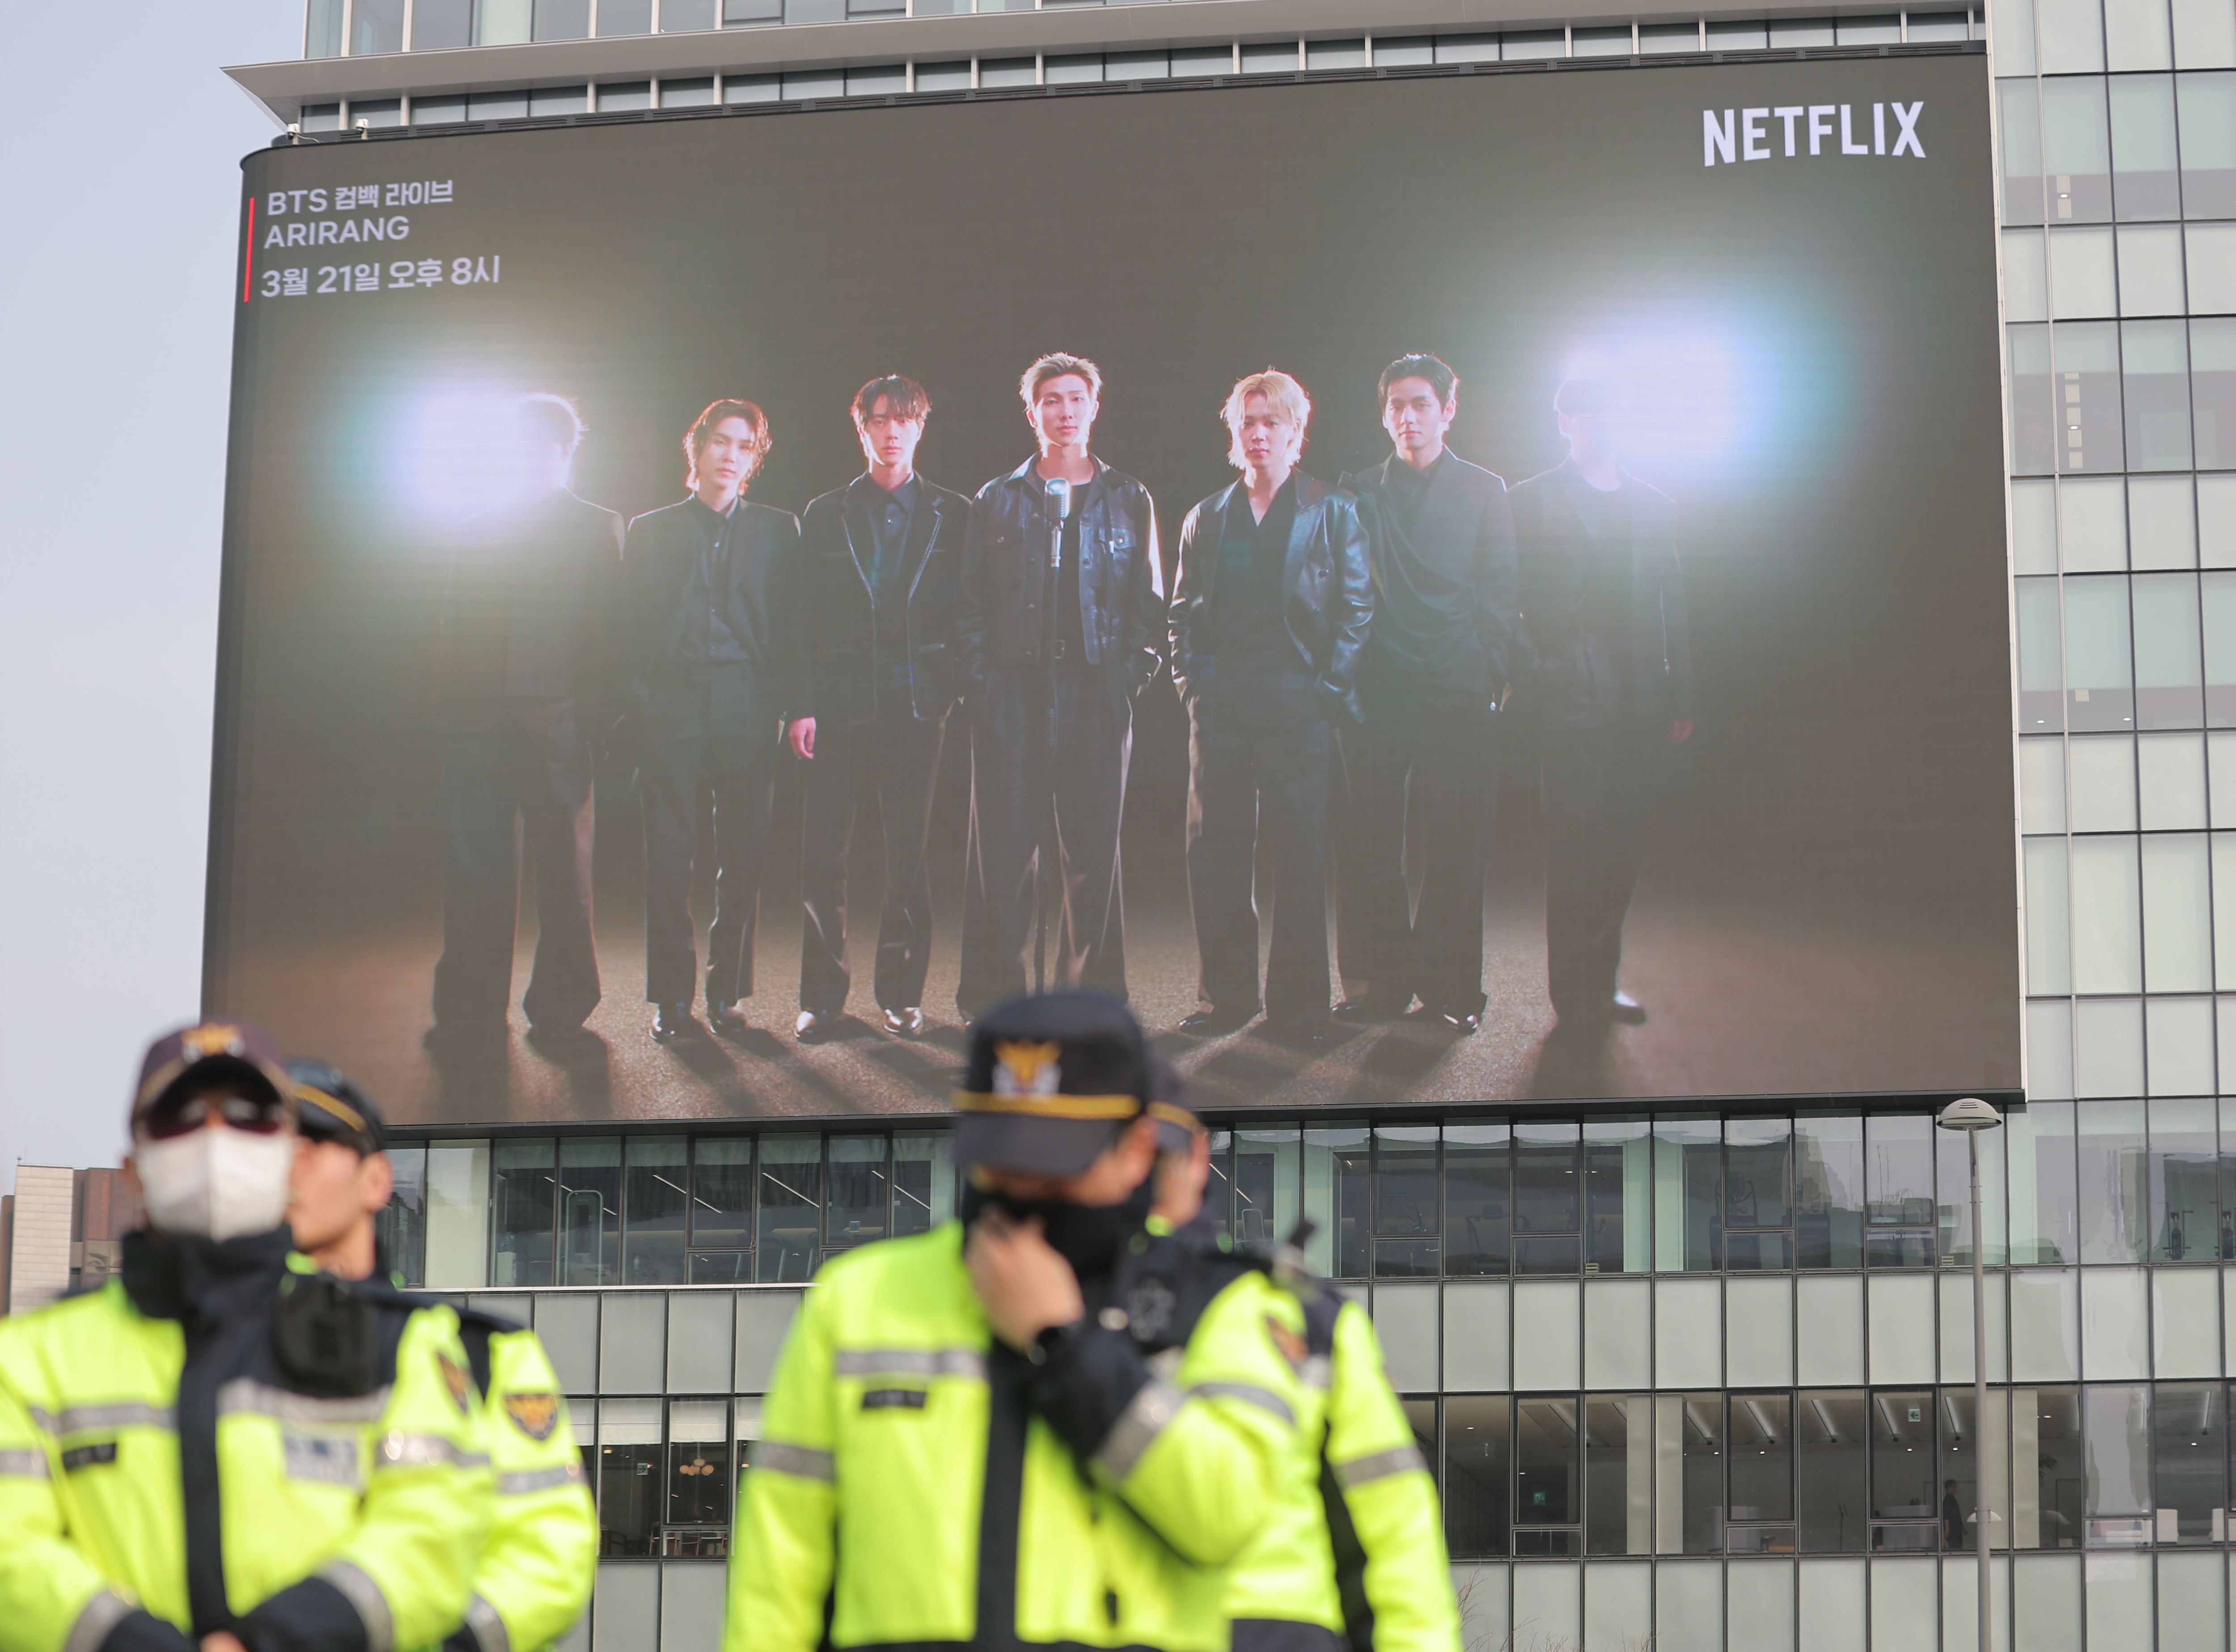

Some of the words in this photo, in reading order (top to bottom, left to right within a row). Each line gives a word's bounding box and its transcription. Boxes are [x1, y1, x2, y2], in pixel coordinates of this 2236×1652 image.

[1703, 101, 1926, 167] NETFLIX
[268, 188, 328, 216] BTS
[335, 185, 379, 210] 컴백
[385, 180, 453, 206] 라이브
[264, 216, 410, 249] ARIRANG
[261, 267, 309, 297] 3월
[317, 263, 380, 293] 21일
[387, 258, 443, 289] 오후
[450, 255, 500, 285] 8시
